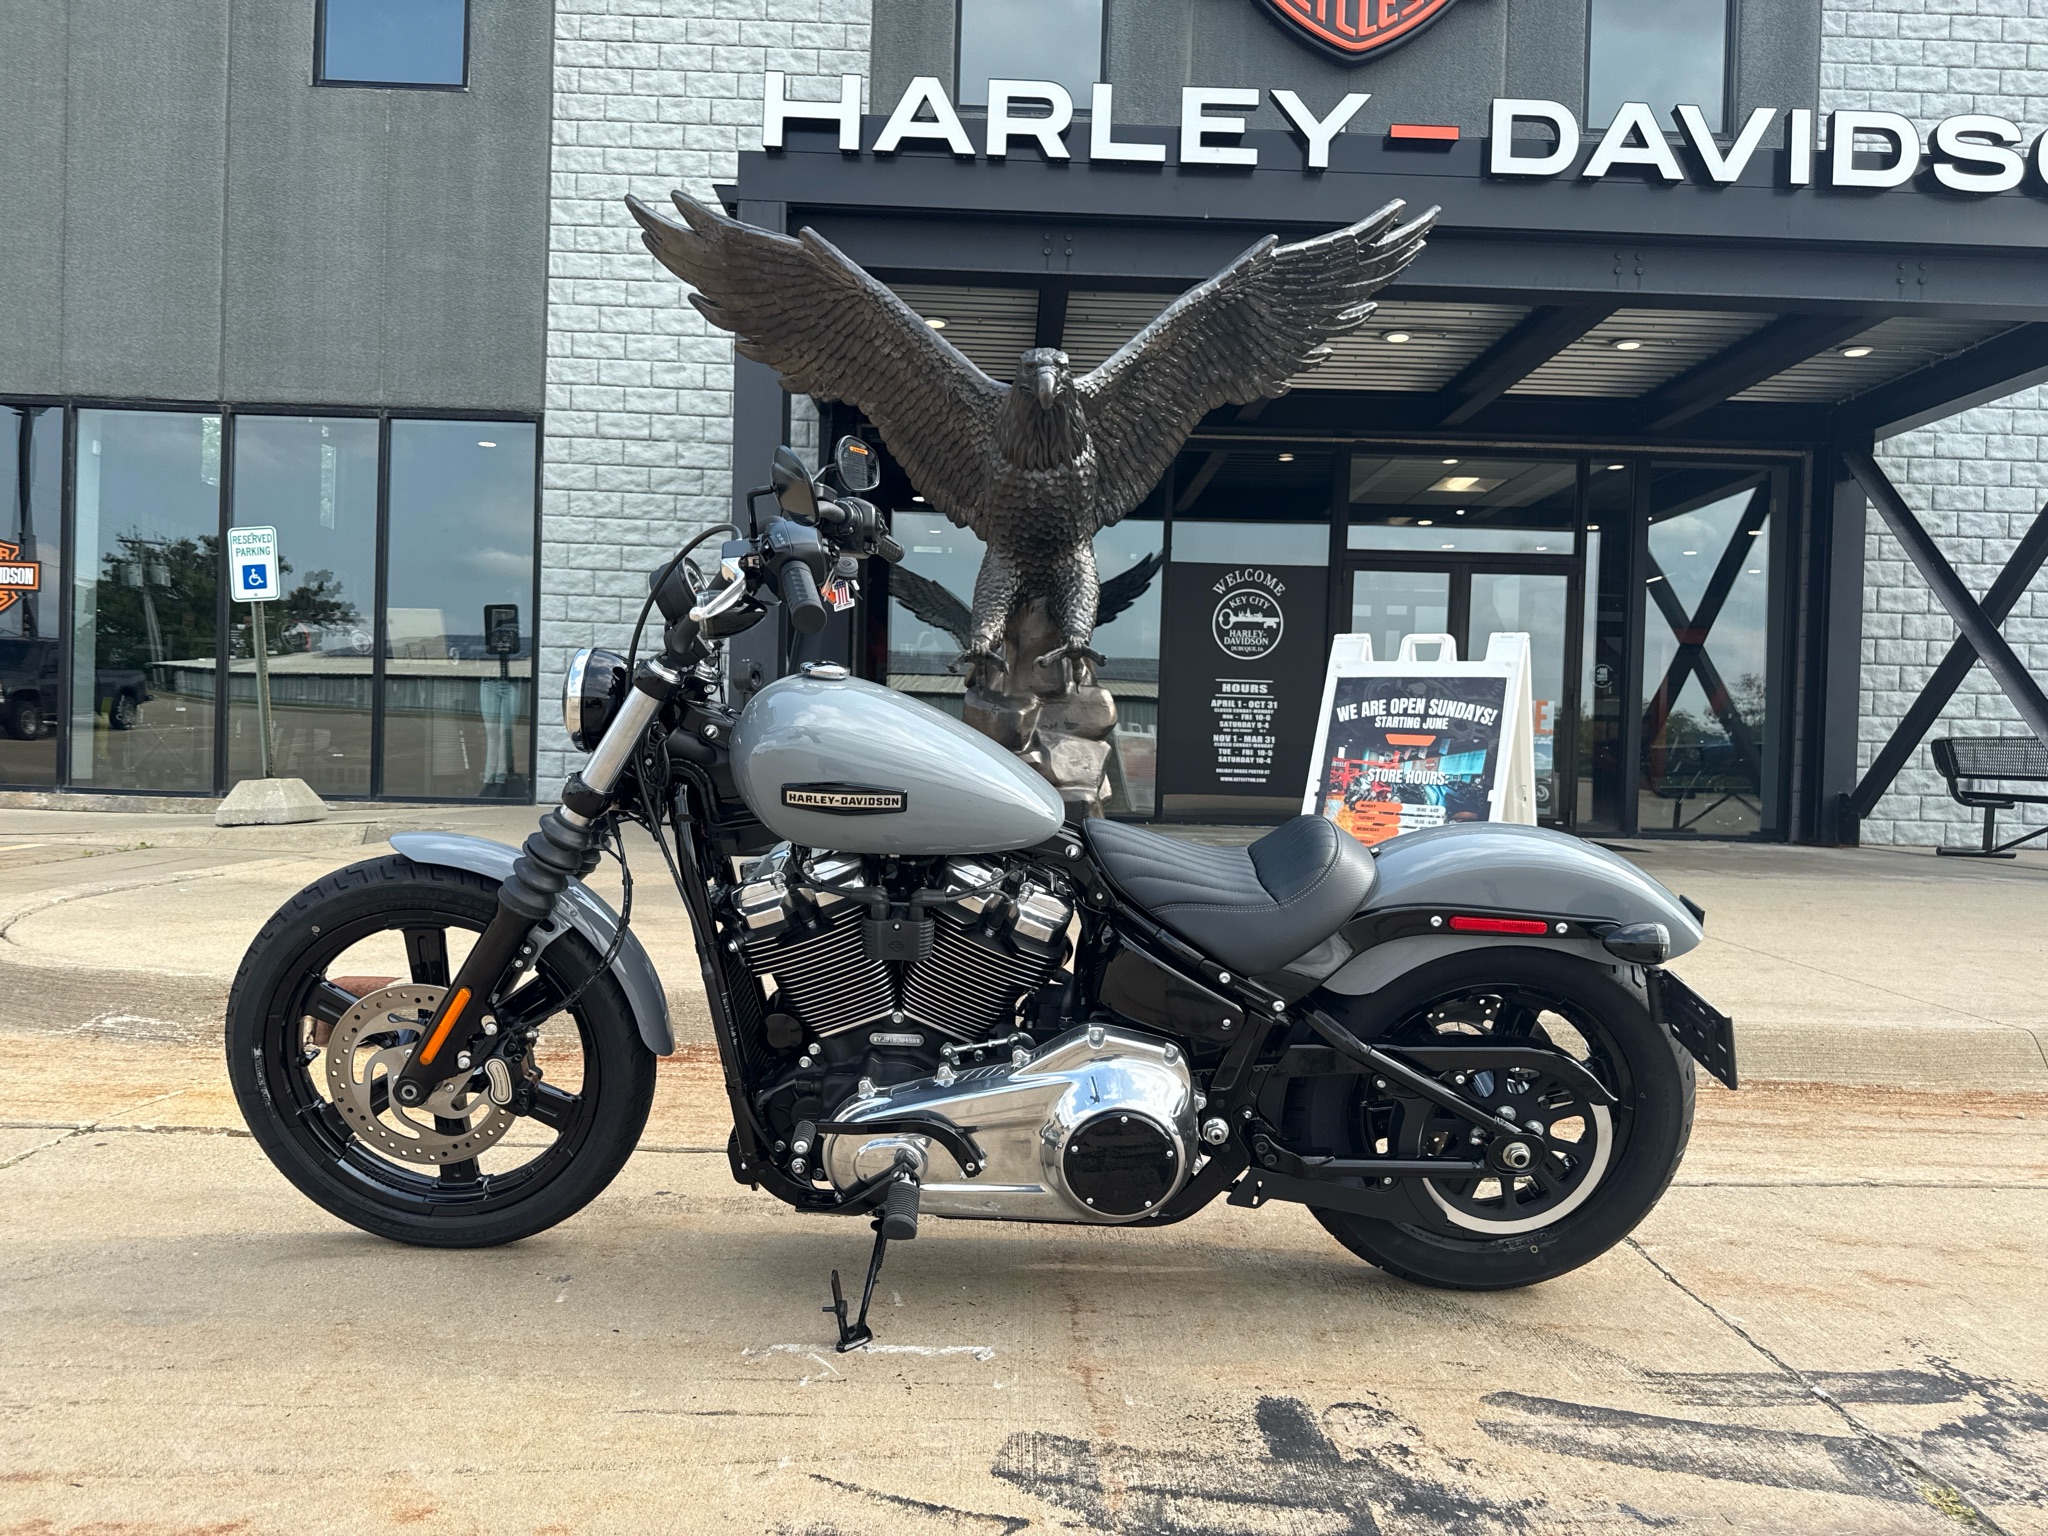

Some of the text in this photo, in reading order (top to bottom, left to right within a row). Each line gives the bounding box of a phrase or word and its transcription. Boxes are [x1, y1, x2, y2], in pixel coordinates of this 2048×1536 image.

[232, 534, 272, 544] RESERVED
[236, 546, 270, 557] PARKING
[1212, 568, 1286, 596] WELCOME
[1229, 596, 1271, 610] KEY CITY
[1229, 630, 1267, 638] HARLEY-
[1224, 637, 1268, 646] DAVIDSON
[1222, 683, 1268, 694] HOURS
[1211, 699, 1236, 707] APRIL
[1336, 698, 1498, 726] WE ARE OPEN SUNDAYS!
[1375, 716, 1448, 730] STARTING JUNE
[1367, 768, 1449, 785] STORE HOURS:
[789, 794, 899, 806] HARLEY-DAVIDSON
